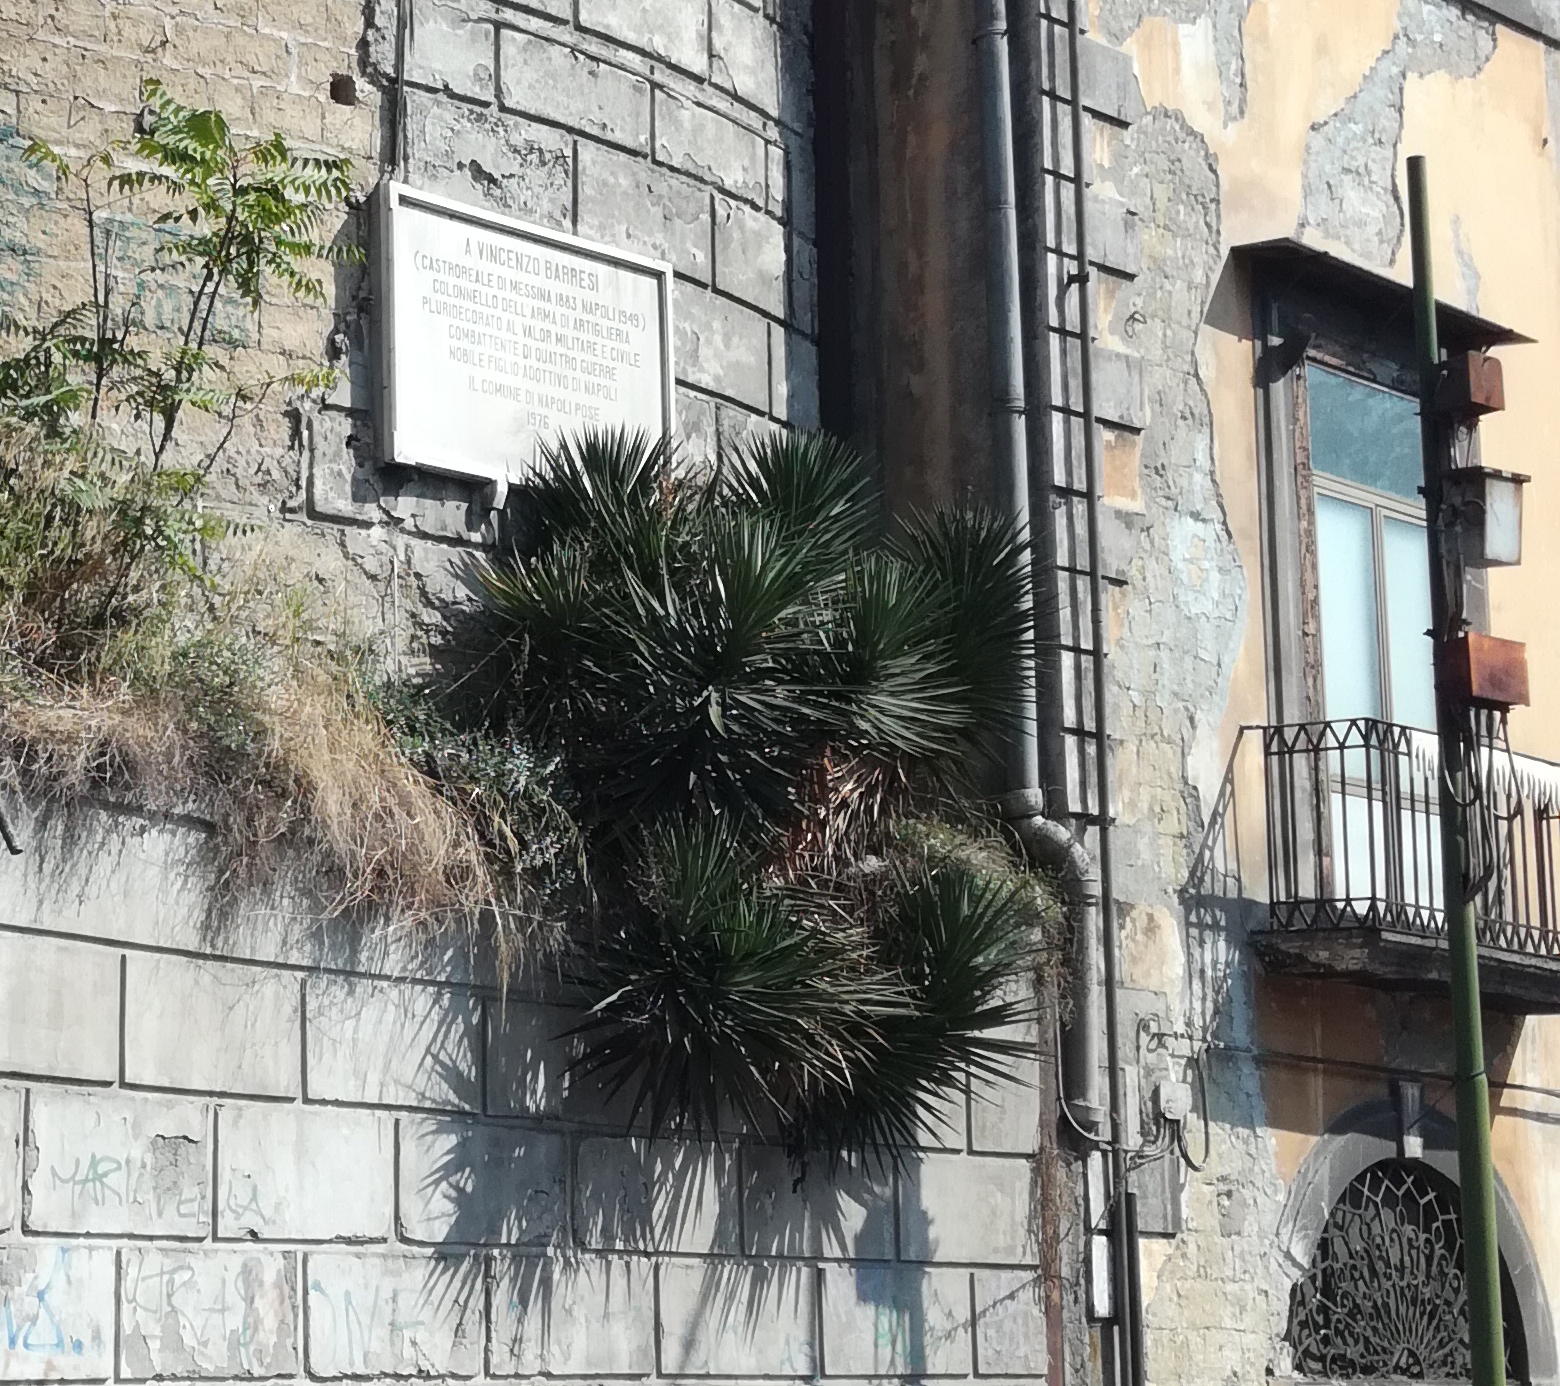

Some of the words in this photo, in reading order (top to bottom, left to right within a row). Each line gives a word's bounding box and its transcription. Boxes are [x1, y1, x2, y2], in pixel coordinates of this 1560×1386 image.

[414, 250, 494, 288] (CASTROREALE
[497, 275, 507, 291] DI
[510, 278, 553, 305] MESSINA
[555, 293, 577, 311] 1883
[581, 299, 616, 322] NAPOLI
[618, 310, 646, 332] 1949)
[465, 238, 472, 257] A
[477, 240, 540, 276] VINCENZO
[545, 259, 598, 292] BARRESI
[422, 295, 502, 331] PLURIDECORATO
[506, 318, 519, 336] AL
[521, 322, 552, 345] VALOR
[555, 332, 598, 357] MILITARE
[601, 343, 608, 359] E
[610, 347, 641, 368] CIVILE
[433, 278, 498, 309] COLONNELLO
[560, 313, 570, 330] DI
[572, 317, 630, 345] ARTIGLIERIA
[448, 323, 520, 357] COMBATTENTE
[522, 343, 532, 360] DI
[534, 347, 577, 372] QUATTRO
[580, 359, 618, 382] GUERRE
[449, 344, 485, 369] NOBILE
[487, 354, 519, 376] FIGLIO
[522, 363, 569, 390] ADOTTIVO
[571, 376, 581, 393] DI
[584, 380, 618, 402] NAPOLI
[468, 374, 479, 392] IL
[481, 378, 522, 404] COMUNE
[525, 388, 535, 407] DI
[537, 392, 572, 416] NAPOLI
[574, 402, 600, 423] POSE
[526, 410, 550, 430] 1976
